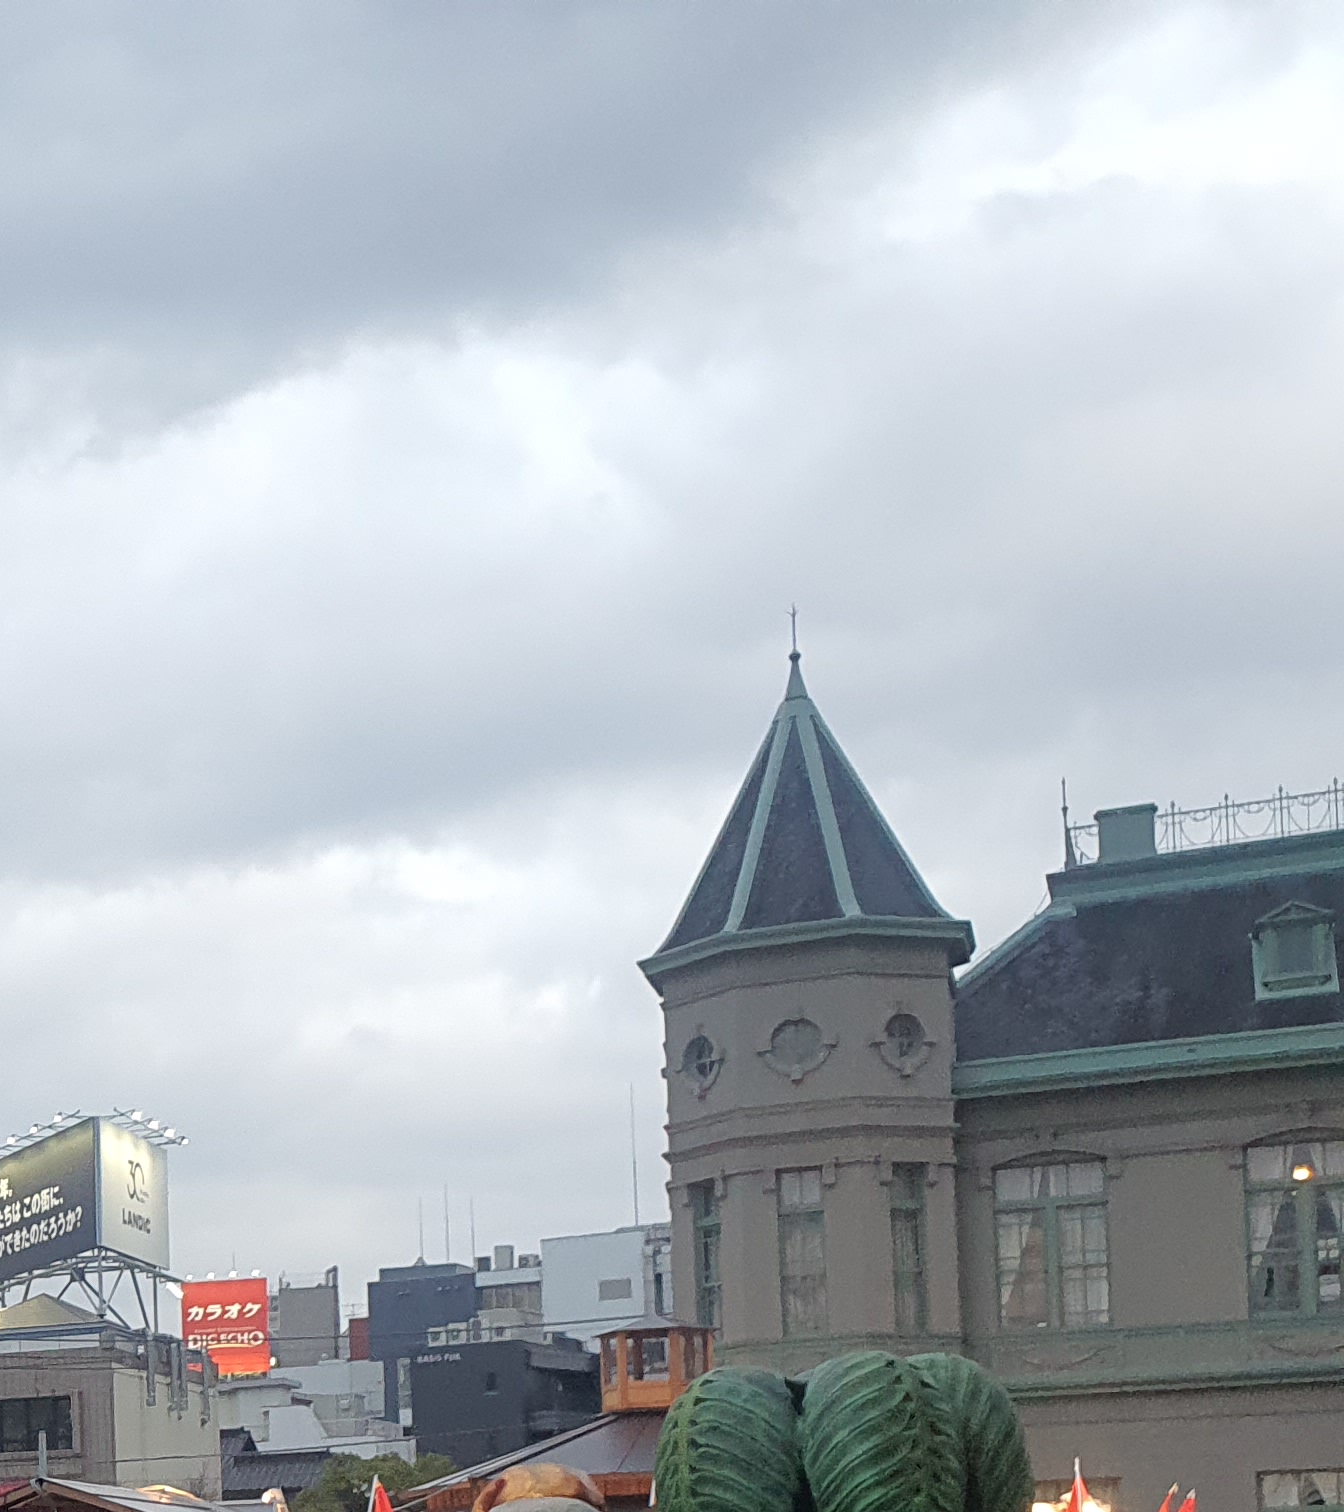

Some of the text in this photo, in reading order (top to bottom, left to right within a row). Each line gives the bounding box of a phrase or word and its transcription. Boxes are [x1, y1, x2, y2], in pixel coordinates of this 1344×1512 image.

[122, 1207, 151, 1234] LANDIC
[186, 1302, 262, 1322] カラオケ
[219, 1330, 265, 1347] ECHO
